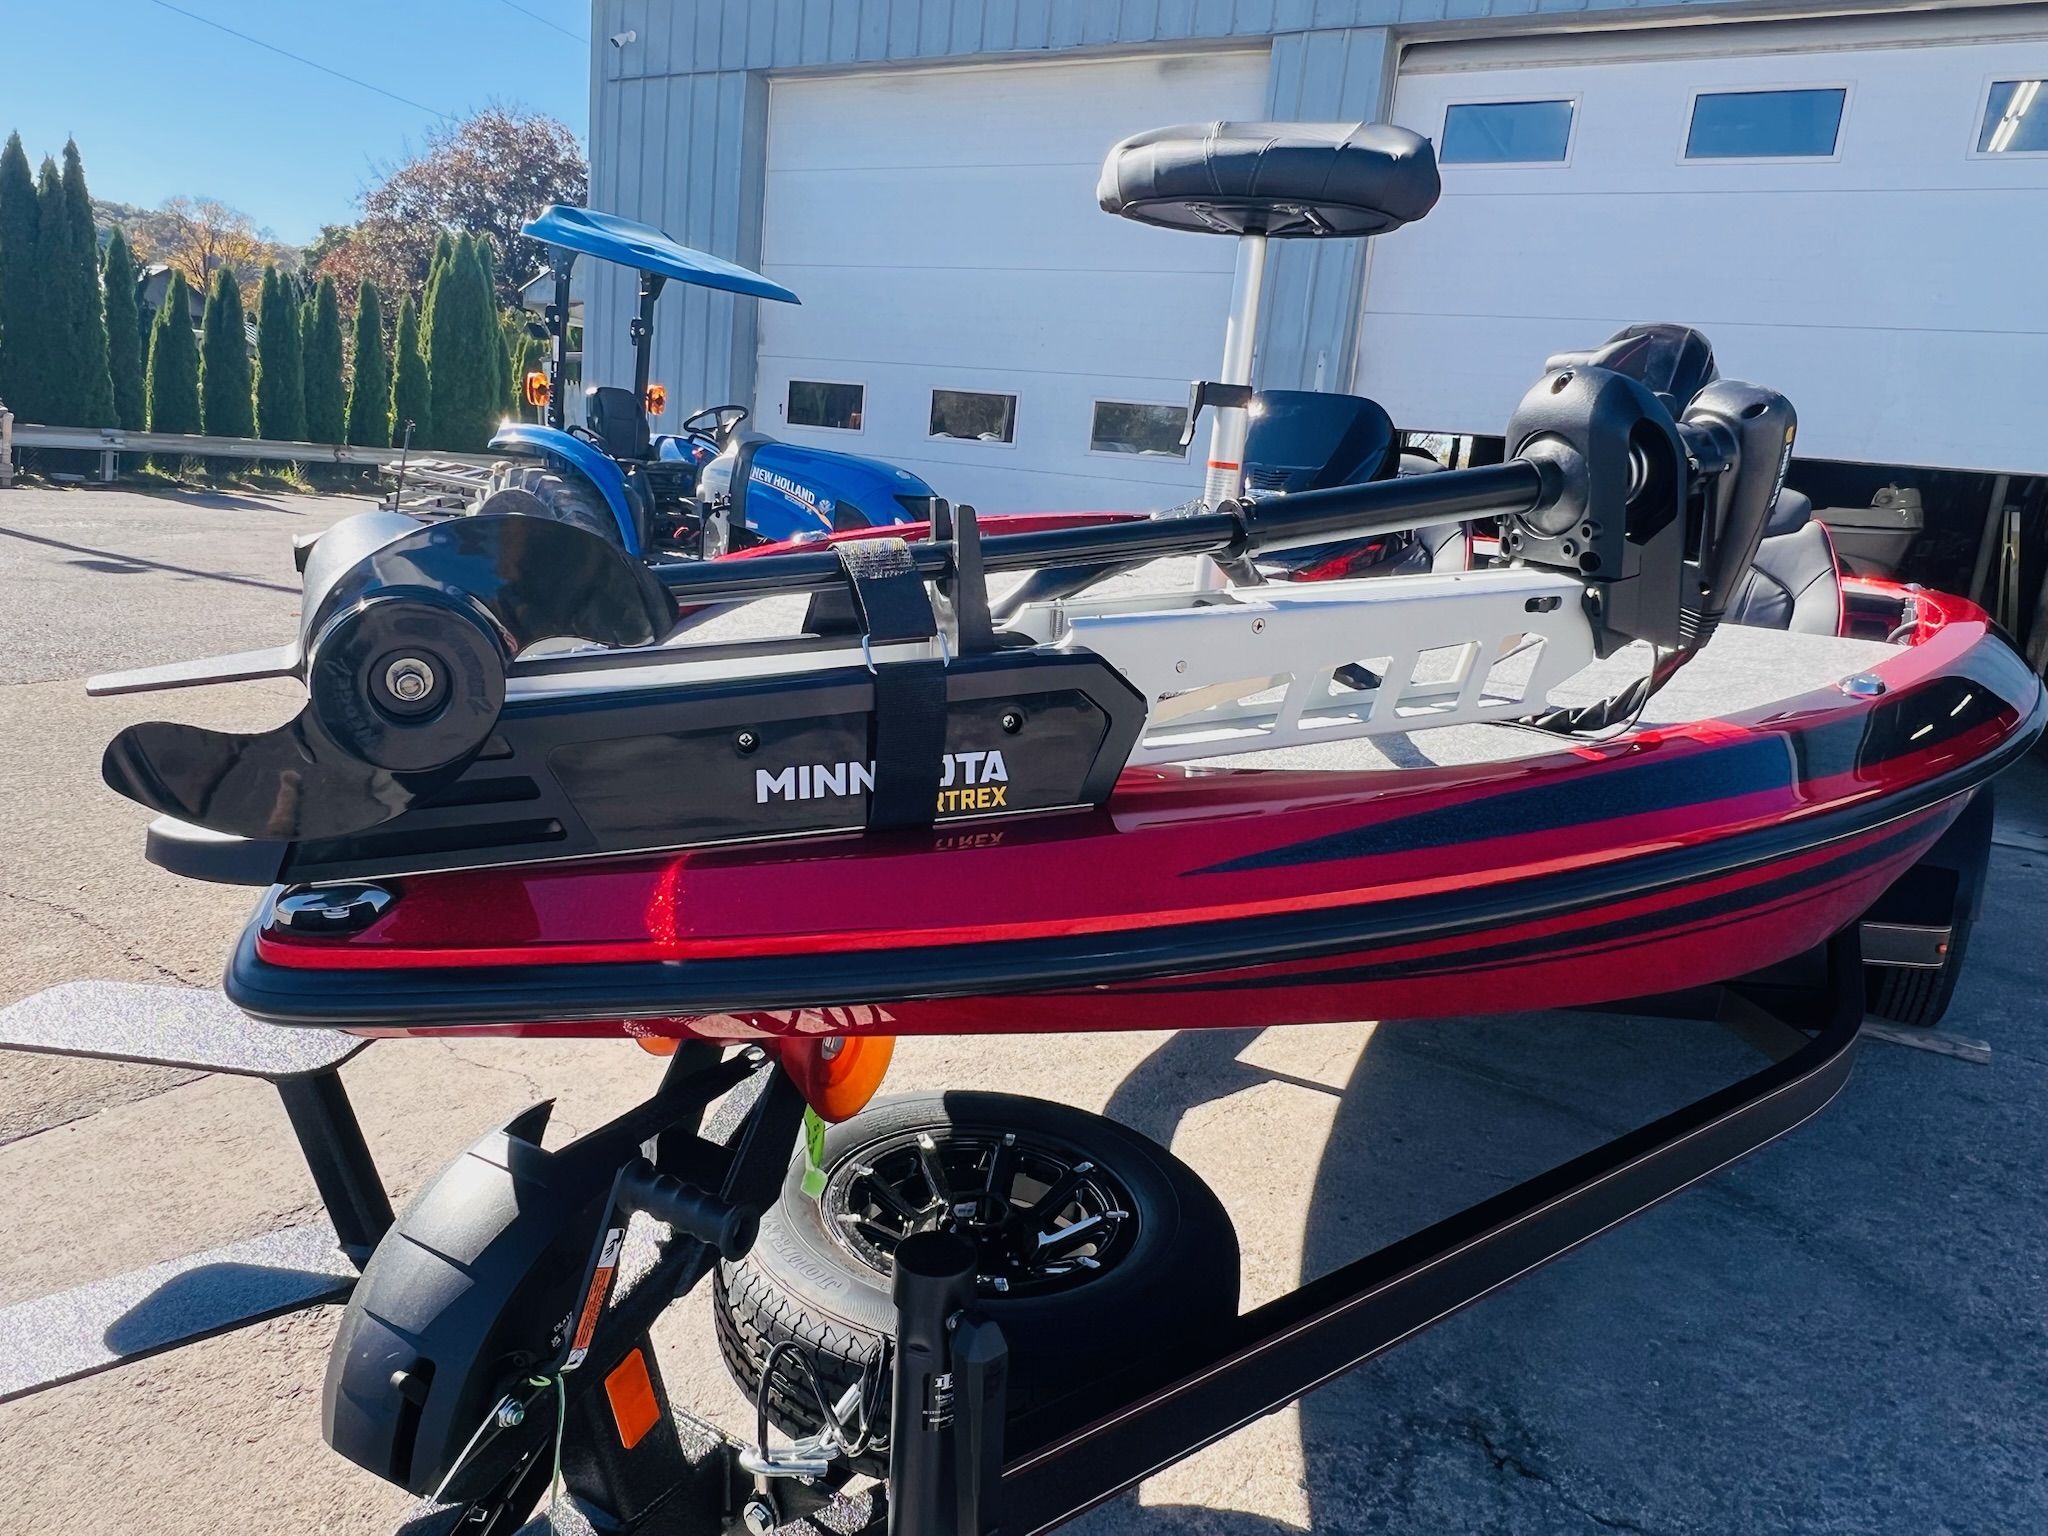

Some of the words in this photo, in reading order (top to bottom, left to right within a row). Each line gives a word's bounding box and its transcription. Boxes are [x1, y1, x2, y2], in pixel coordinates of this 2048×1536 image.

[752, 466, 774, 484] NEW
[773, 474, 816, 505] HOLLAND
[756, 760, 877, 804] MINN
